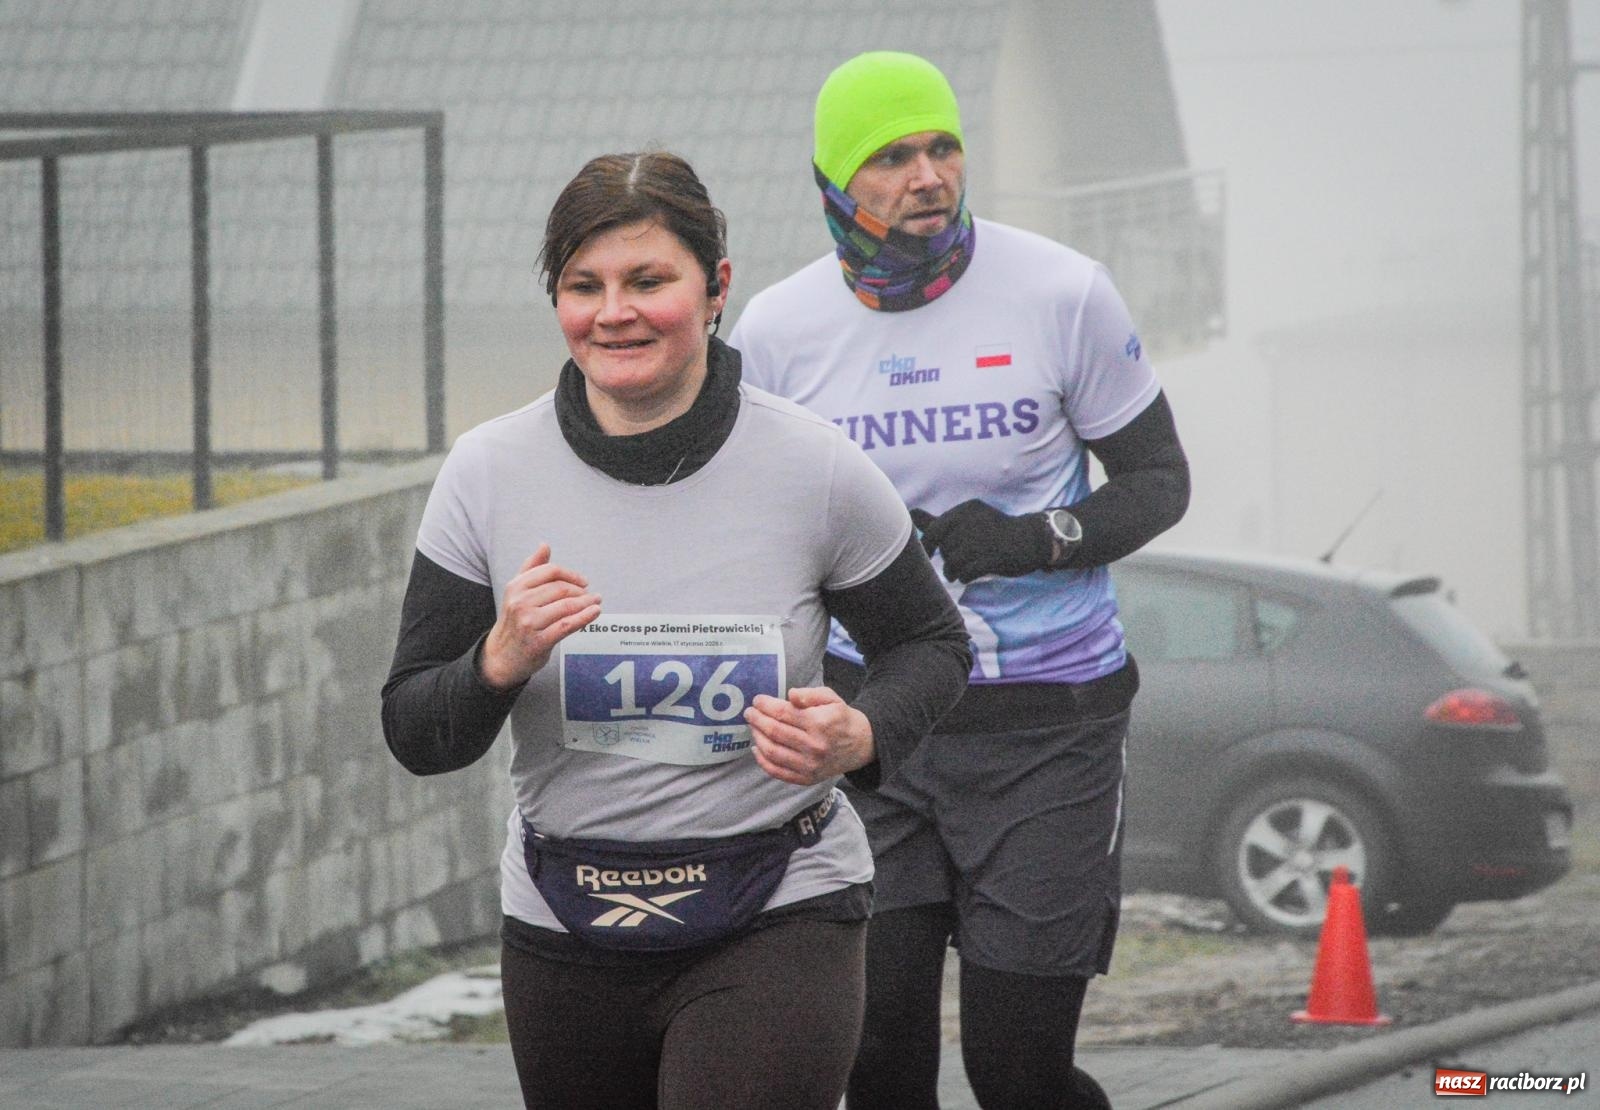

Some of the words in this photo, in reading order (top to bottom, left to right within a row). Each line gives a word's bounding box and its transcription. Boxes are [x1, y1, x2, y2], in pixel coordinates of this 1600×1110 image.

[589, 624, 609, 633] Eko
[610, 624, 642, 633] Cross
[644, 625, 658, 636] po
[659, 623, 691, 633] Ziemi
[692, 623, 764, 635] Pietrowickiej
[603, 660, 745, 721] 126
[576, 864, 707, 891] Reebok
